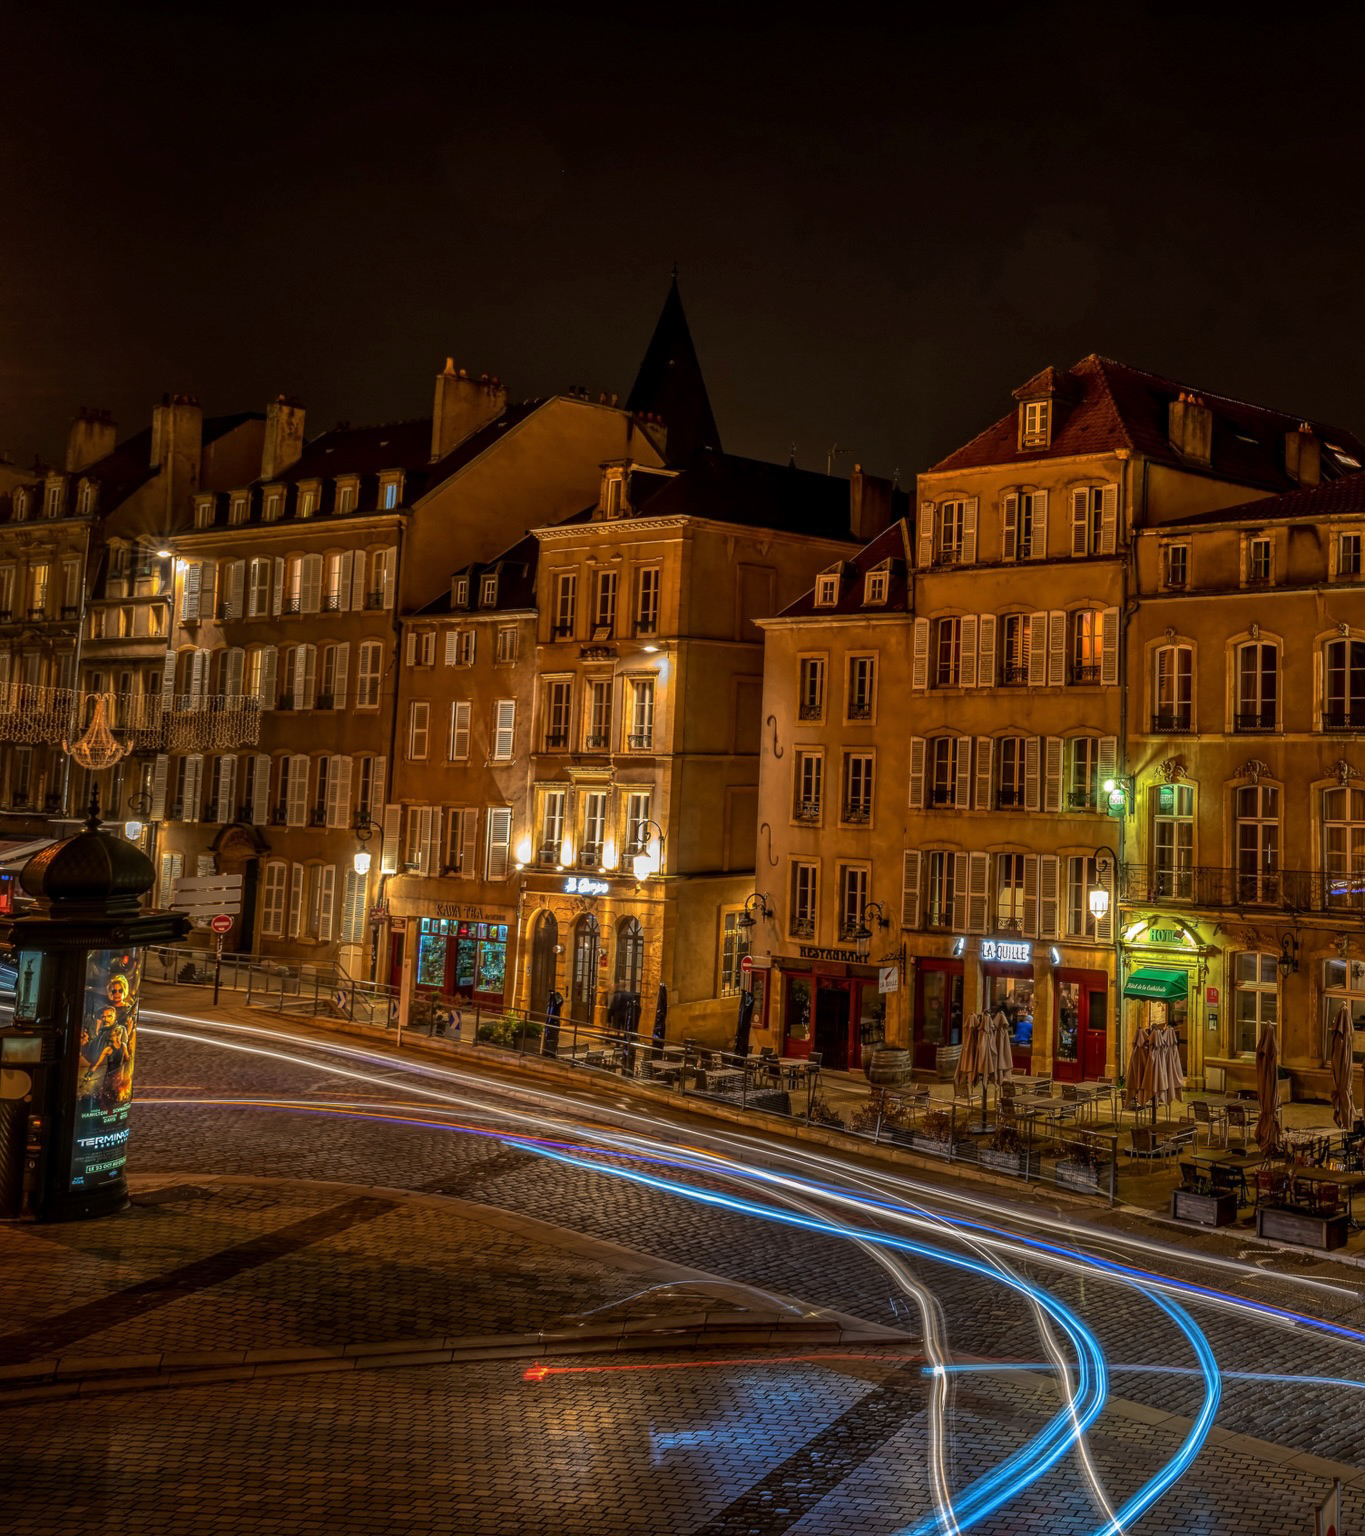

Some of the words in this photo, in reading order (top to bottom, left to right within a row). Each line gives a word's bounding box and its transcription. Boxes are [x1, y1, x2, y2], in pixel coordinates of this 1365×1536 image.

[436, 904, 461, 919] KAWA
[464, 907, 483, 919] TEA
[799, 945, 870, 964] RESTAURANT
[982, 943, 994, 958] LA
[996, 944, 1028, 961] QUILLE
